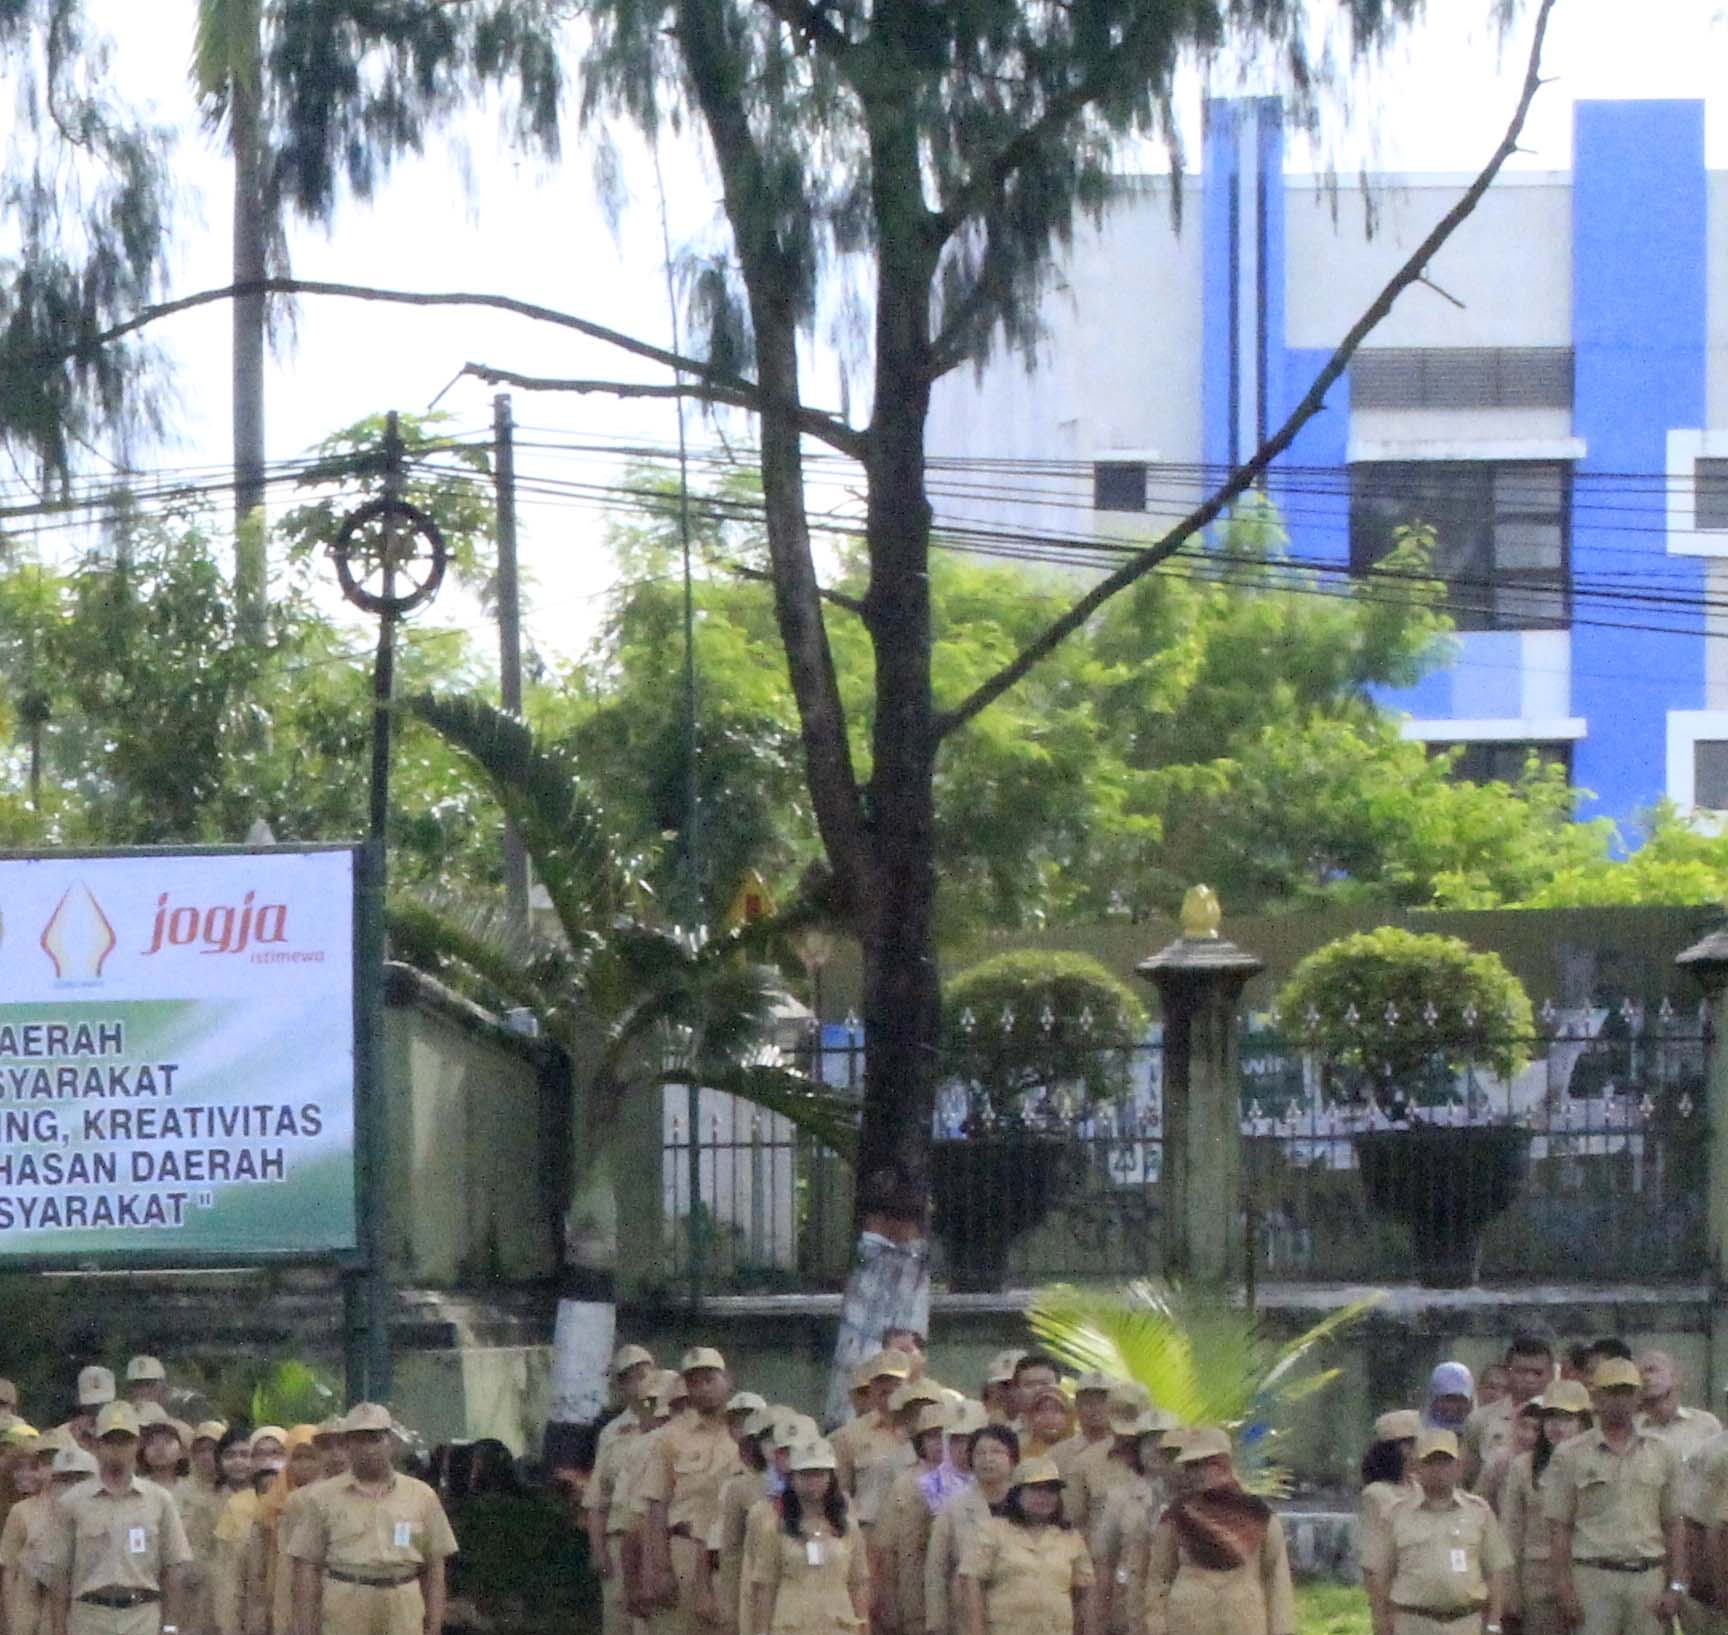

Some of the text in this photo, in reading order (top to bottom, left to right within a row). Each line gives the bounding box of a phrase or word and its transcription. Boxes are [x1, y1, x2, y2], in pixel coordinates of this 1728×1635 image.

[141, 890, 289, 955] jogja
[250, 950, 326, 965] istimewa
[83, 1103, 323, 1141] KREATIVITAS
[131, 1148, 284, 1182] DAERAH
